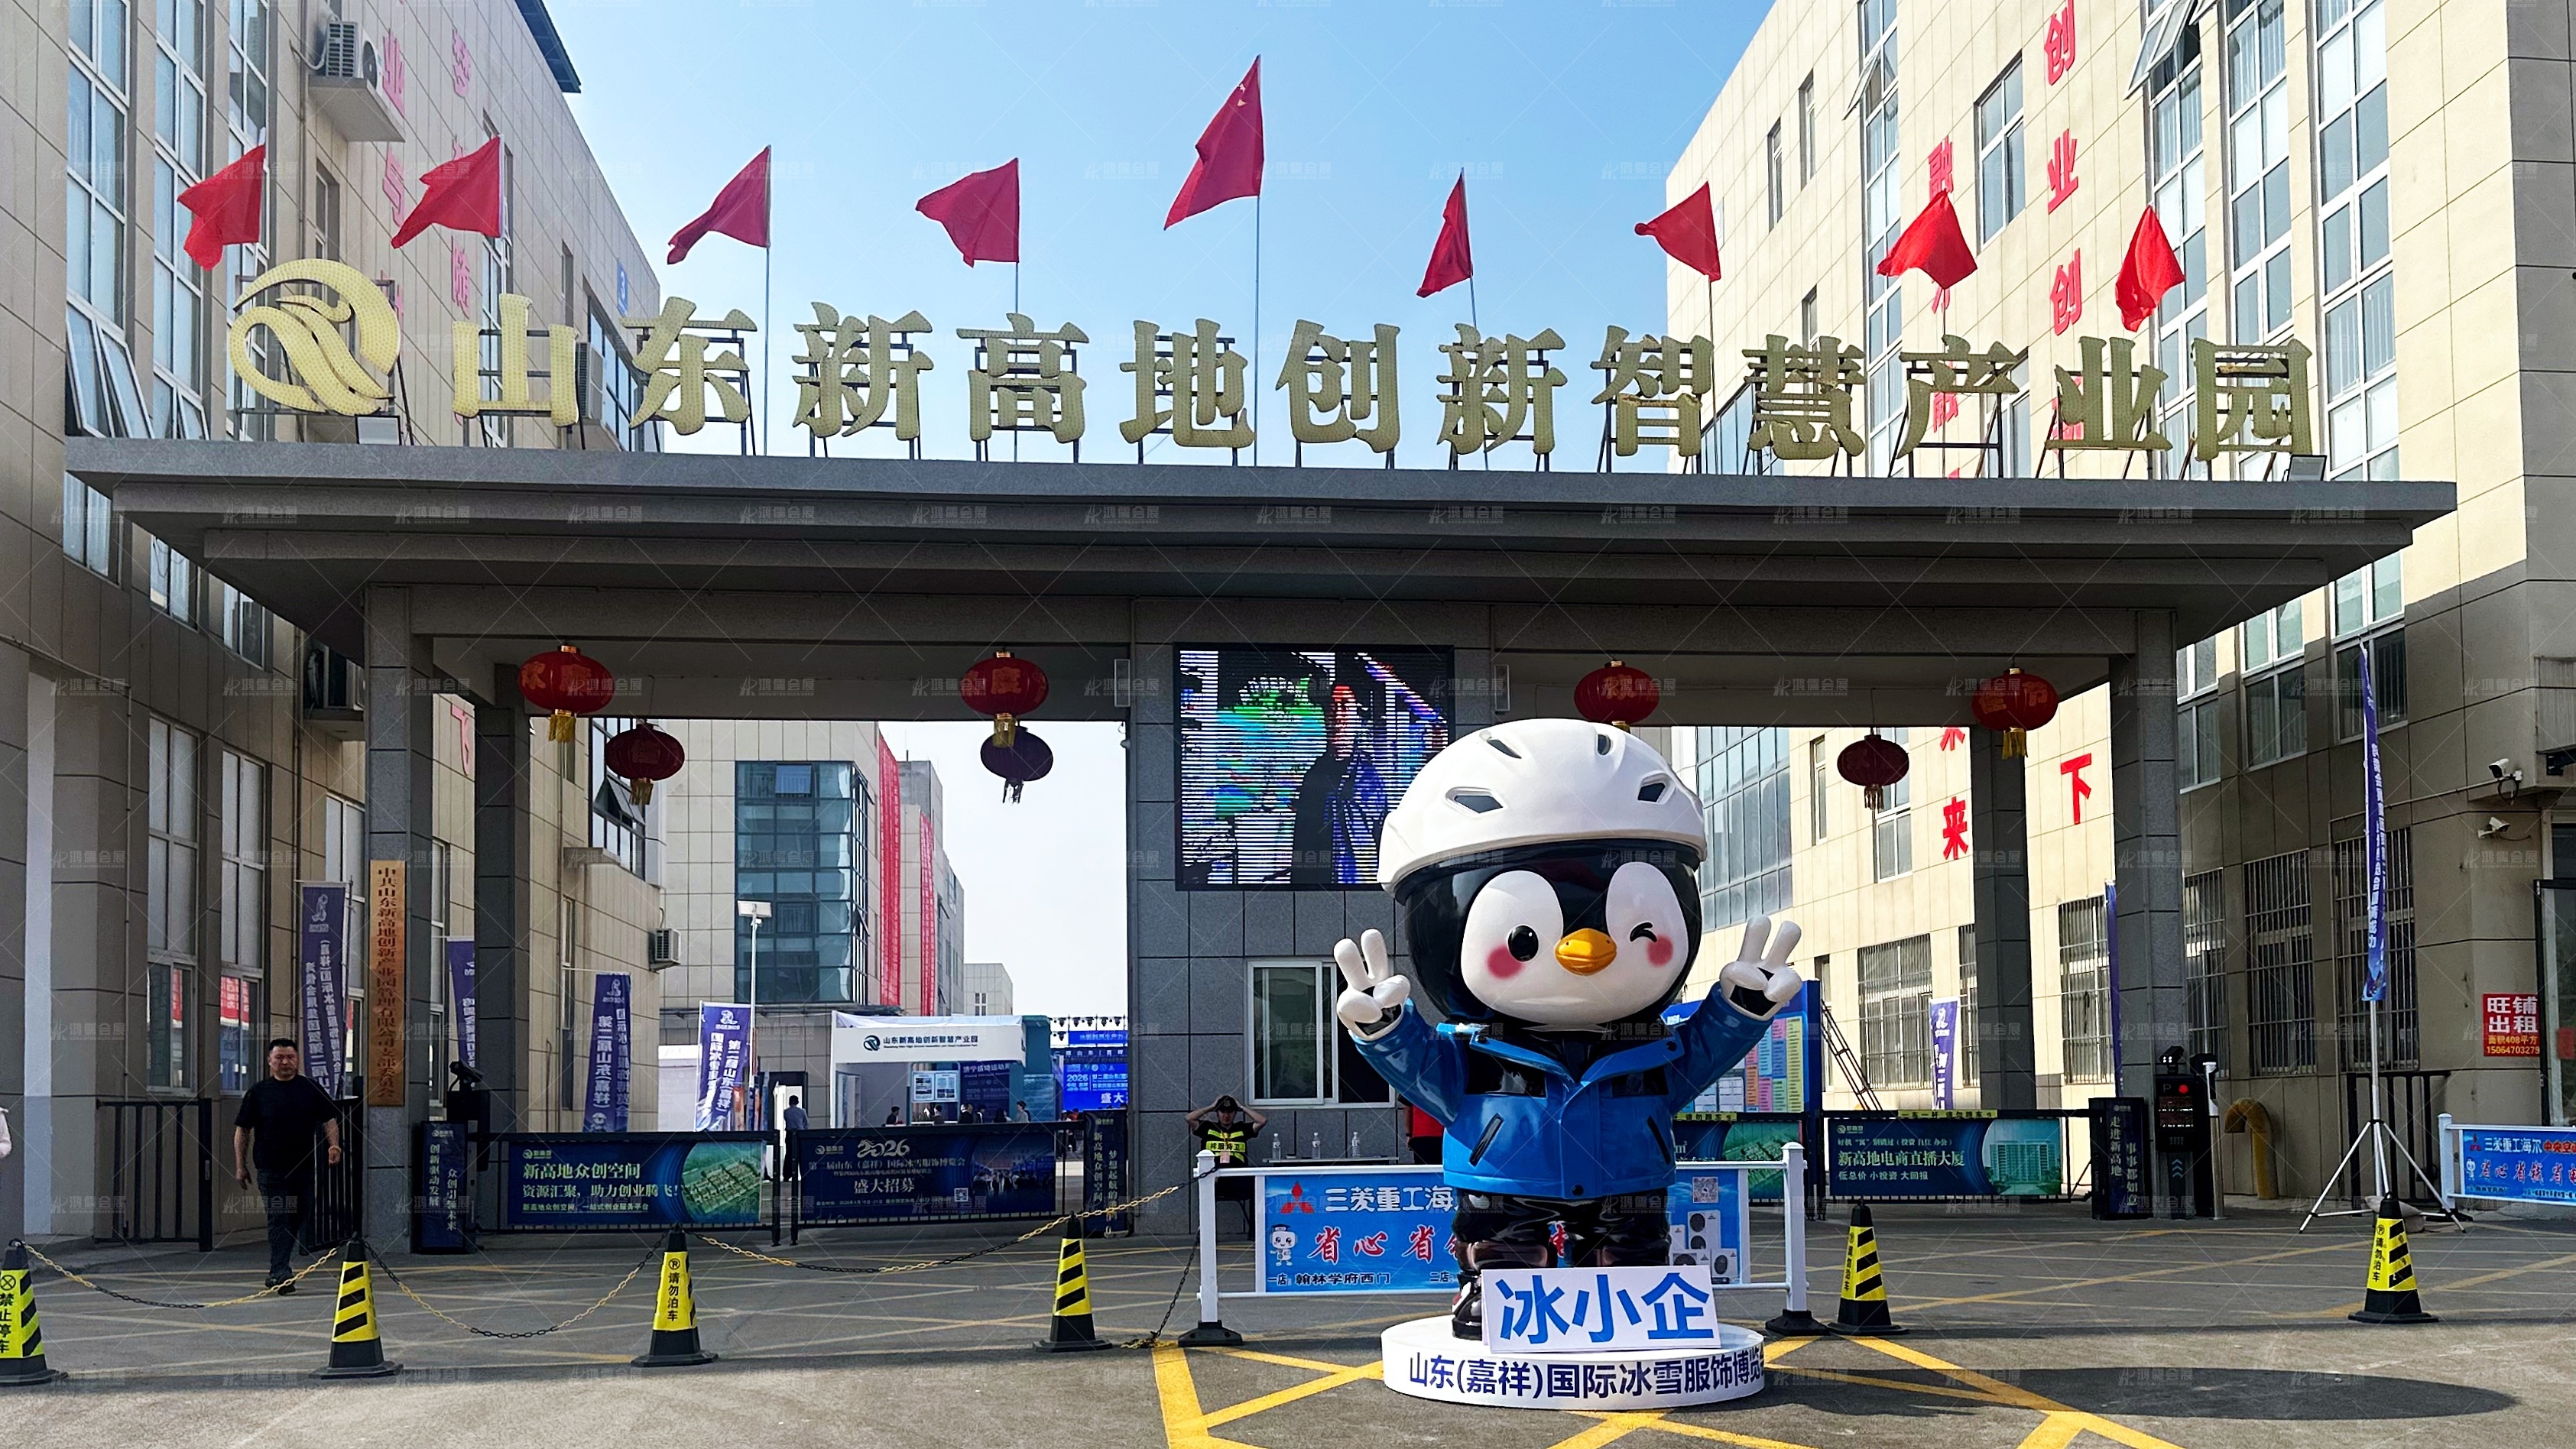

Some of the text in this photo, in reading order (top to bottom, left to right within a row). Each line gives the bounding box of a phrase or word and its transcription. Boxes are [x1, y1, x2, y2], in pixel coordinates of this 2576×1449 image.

[453, 295, 2312, 461] 山东新高地创新智慧产业园
[2060, 754, 2091, 825] 下
[2487, 996, 2538, 1014] 旺铺
[2488, 1015, 2538, 1033] 出租
[2488, 1036, 2538, 1045] 面积408平方
[1838, 1150, 1966, 1167] 新高地电商直播大厦
[2110, 1116, 2123, 1177] 走进新高地
[2484, 1137, 2542, 1154] 三菱重工海尔
[522, 1162, 641, 1180] 新高地众创空间
[852, 1177, 916, 1195] 盛大招募
[1838, 1171, 1929, 1181] 低总价 小投资 大回报
[2126, 1143, 2139, 1207] 事事都如意
[2372, 1238, 2383, 1282] 请勿泊车
[666, 1272, 680, 1323] 请勿泊车
[1495, 1272, 1714, 1345] 冰小企
[0, 1292, 15, 1354] 禁止停车
